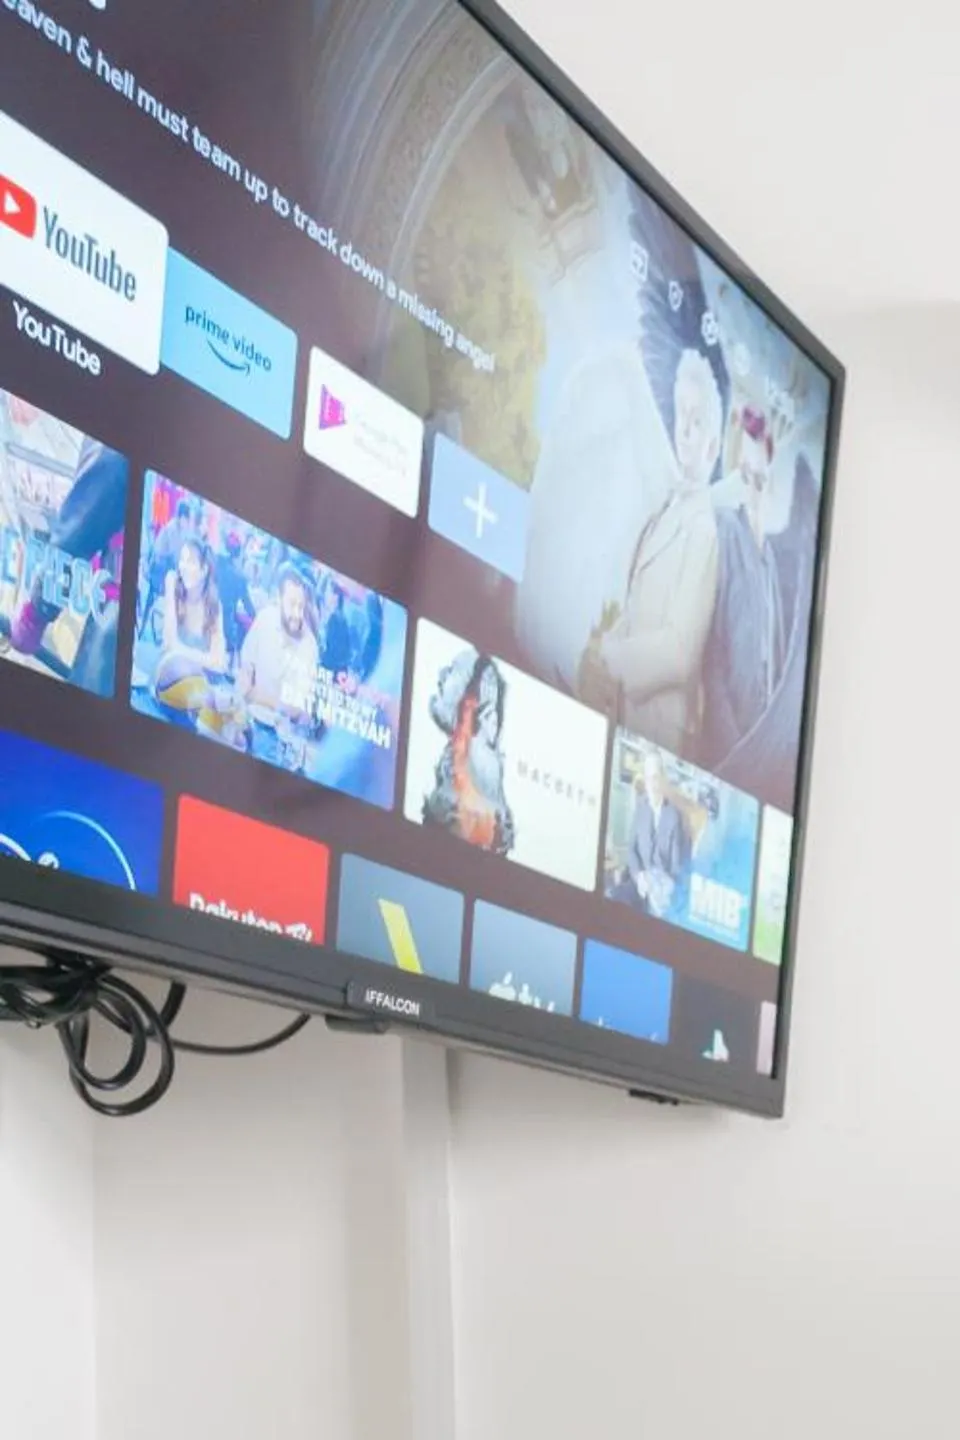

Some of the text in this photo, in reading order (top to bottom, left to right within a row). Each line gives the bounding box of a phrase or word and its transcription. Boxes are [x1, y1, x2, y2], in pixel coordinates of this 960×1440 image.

[76, 34, 93, 70] &
[96, 49, 136, 100] hell
[137, 86, 190, 142] must
[193, 126, 242, 181] team
[244, 167, 269, 203] up
[272, 187, 291, 217] to
[293, 203, 338, 256] track
[339, 241, 385, 291] down
[386, 278, 398, 300] a
[398, 289, 455, 348] missing
[455, 332, 497, 374] angel
[43, 206, 136, 302] YouTube
[13, 300, 102, 376] YouTube
[185, 303, 273, 372] prime video
